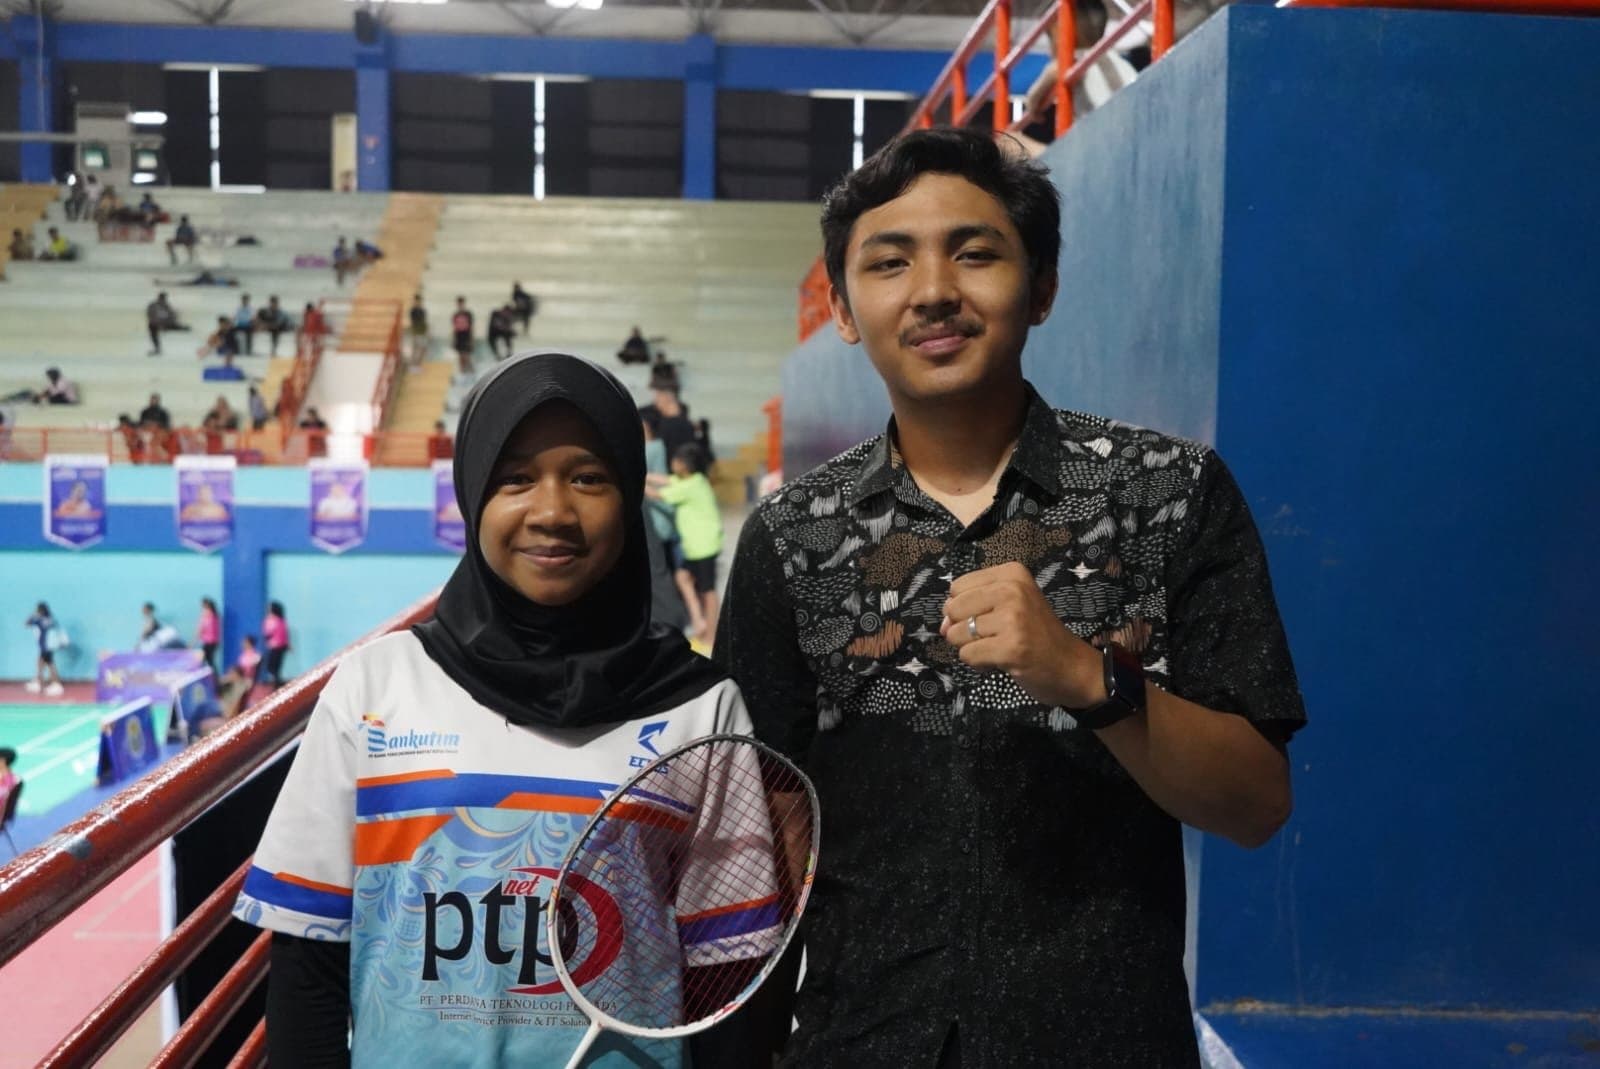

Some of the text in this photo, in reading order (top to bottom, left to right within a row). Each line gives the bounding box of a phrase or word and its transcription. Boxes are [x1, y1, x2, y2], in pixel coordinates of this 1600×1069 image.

[503, 875, 540, 896] net
[421, 880, 579, 985] ptp
[491, 998, 562, 1011] TEKNOLOGI
[498, 1015, 532, 1026] Provider
[534, 1017, 544, 1027] &
[546, 1017, 558, 1027] IT
